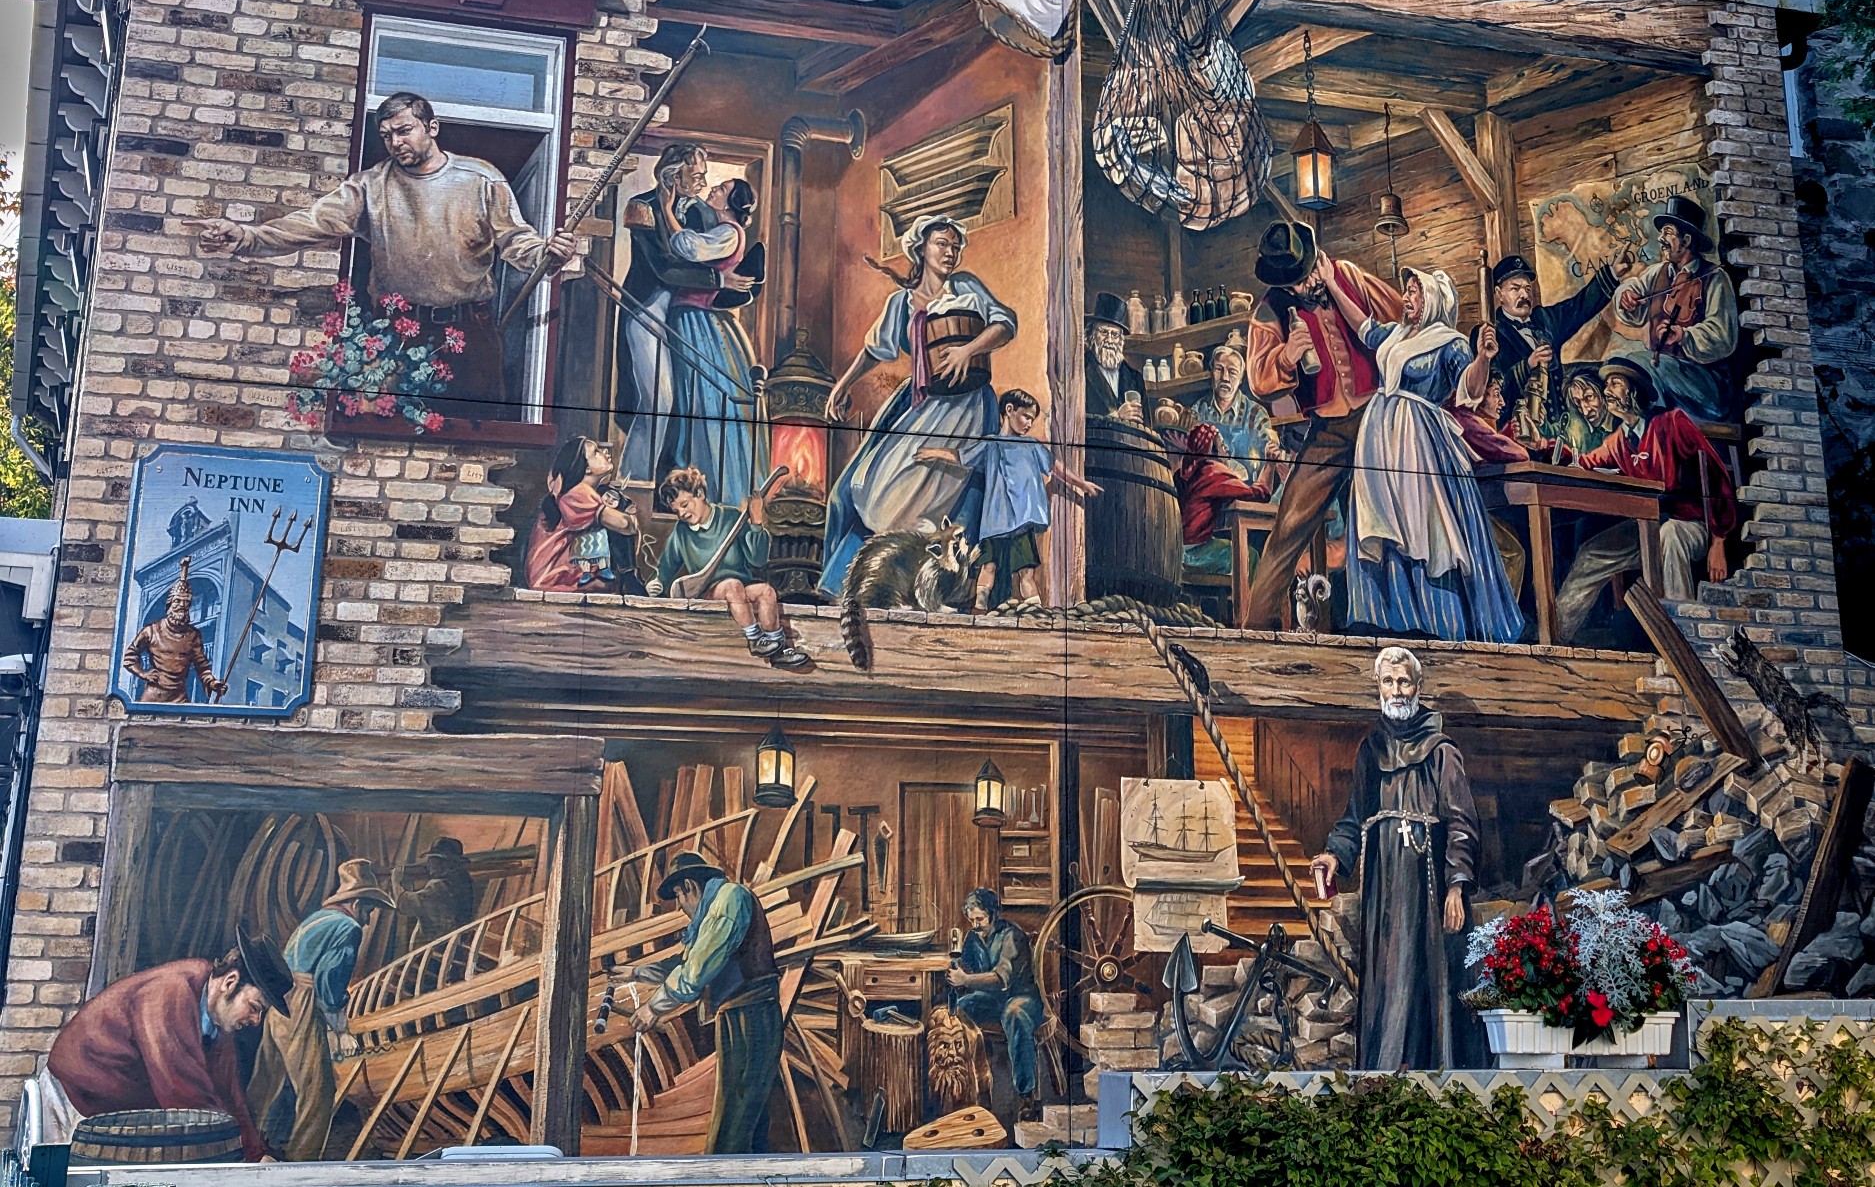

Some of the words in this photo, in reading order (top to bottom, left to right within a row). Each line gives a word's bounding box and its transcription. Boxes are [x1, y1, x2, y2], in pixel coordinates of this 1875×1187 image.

[583, 155, 621, 207] MONTFERRAND
[1633, 178, 1710, 204] GROENLAND
[182, 467, 284, 494] NEPTUNE
[229, 497, 265, 513] INN
